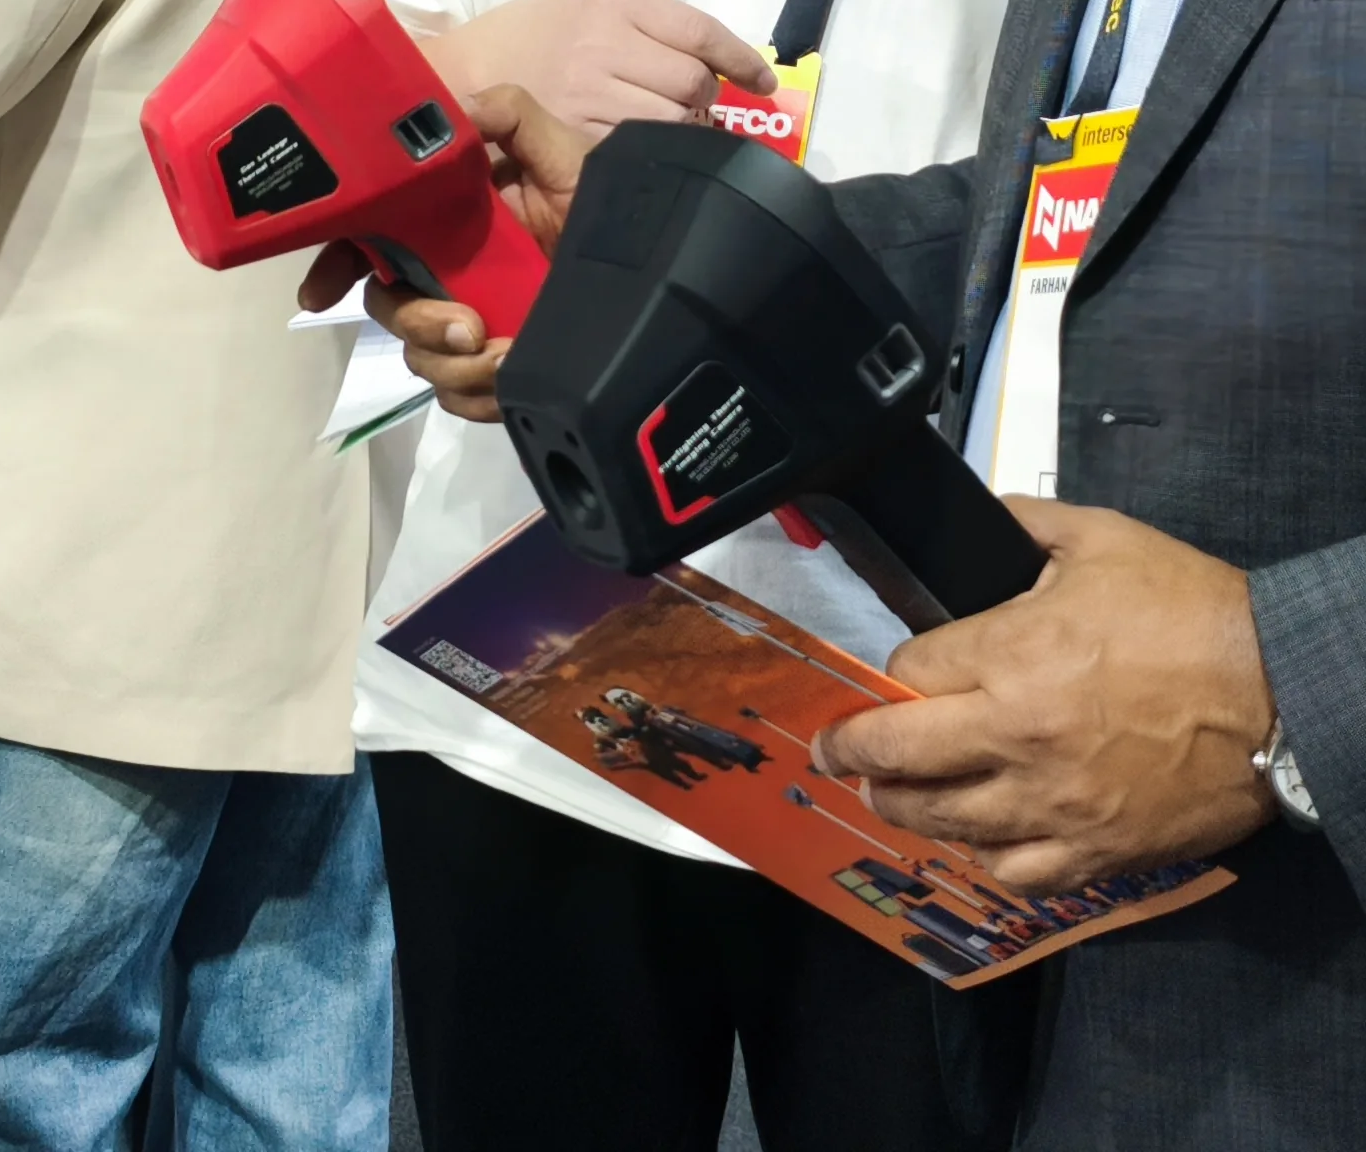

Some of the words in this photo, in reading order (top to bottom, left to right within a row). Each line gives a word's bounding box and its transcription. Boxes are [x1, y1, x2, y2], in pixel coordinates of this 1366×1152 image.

[237, 161, 268, 186] Thermal
[270, 141, 298, 164] Camera
[240, 161, 255, 174] Gas
[257, 137, 288, 162] Leakage
[1031, 277, 1067, 295] FARHAN
[658, 422, 710, 475] Firefighting
[710, 385, 745, 422] Thermal
[675, 438, 710, 472] Imaging
[710, 404, 743, 437] Camera
